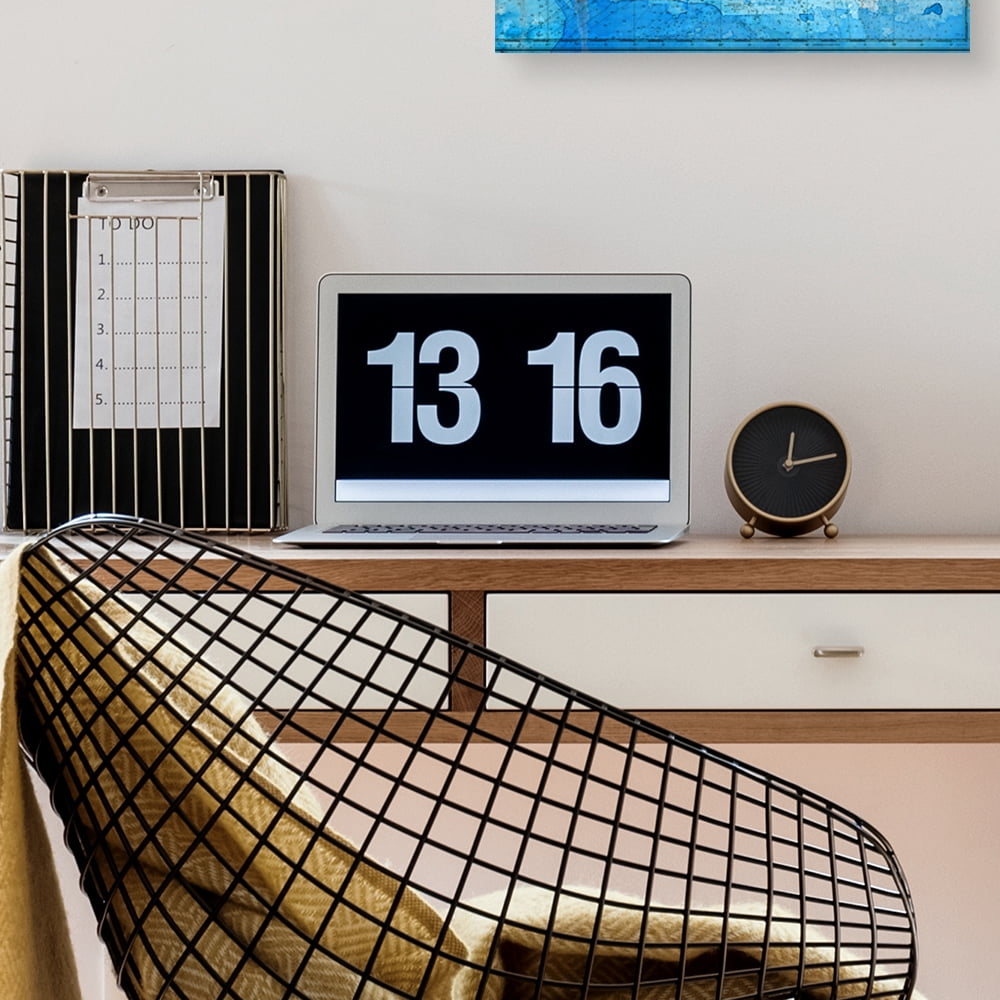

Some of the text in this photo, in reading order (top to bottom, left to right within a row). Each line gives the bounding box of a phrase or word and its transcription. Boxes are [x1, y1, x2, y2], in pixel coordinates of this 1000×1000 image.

[99, 216, 154, 231] TO DO
[367, 330, 642, 445] 13 16
